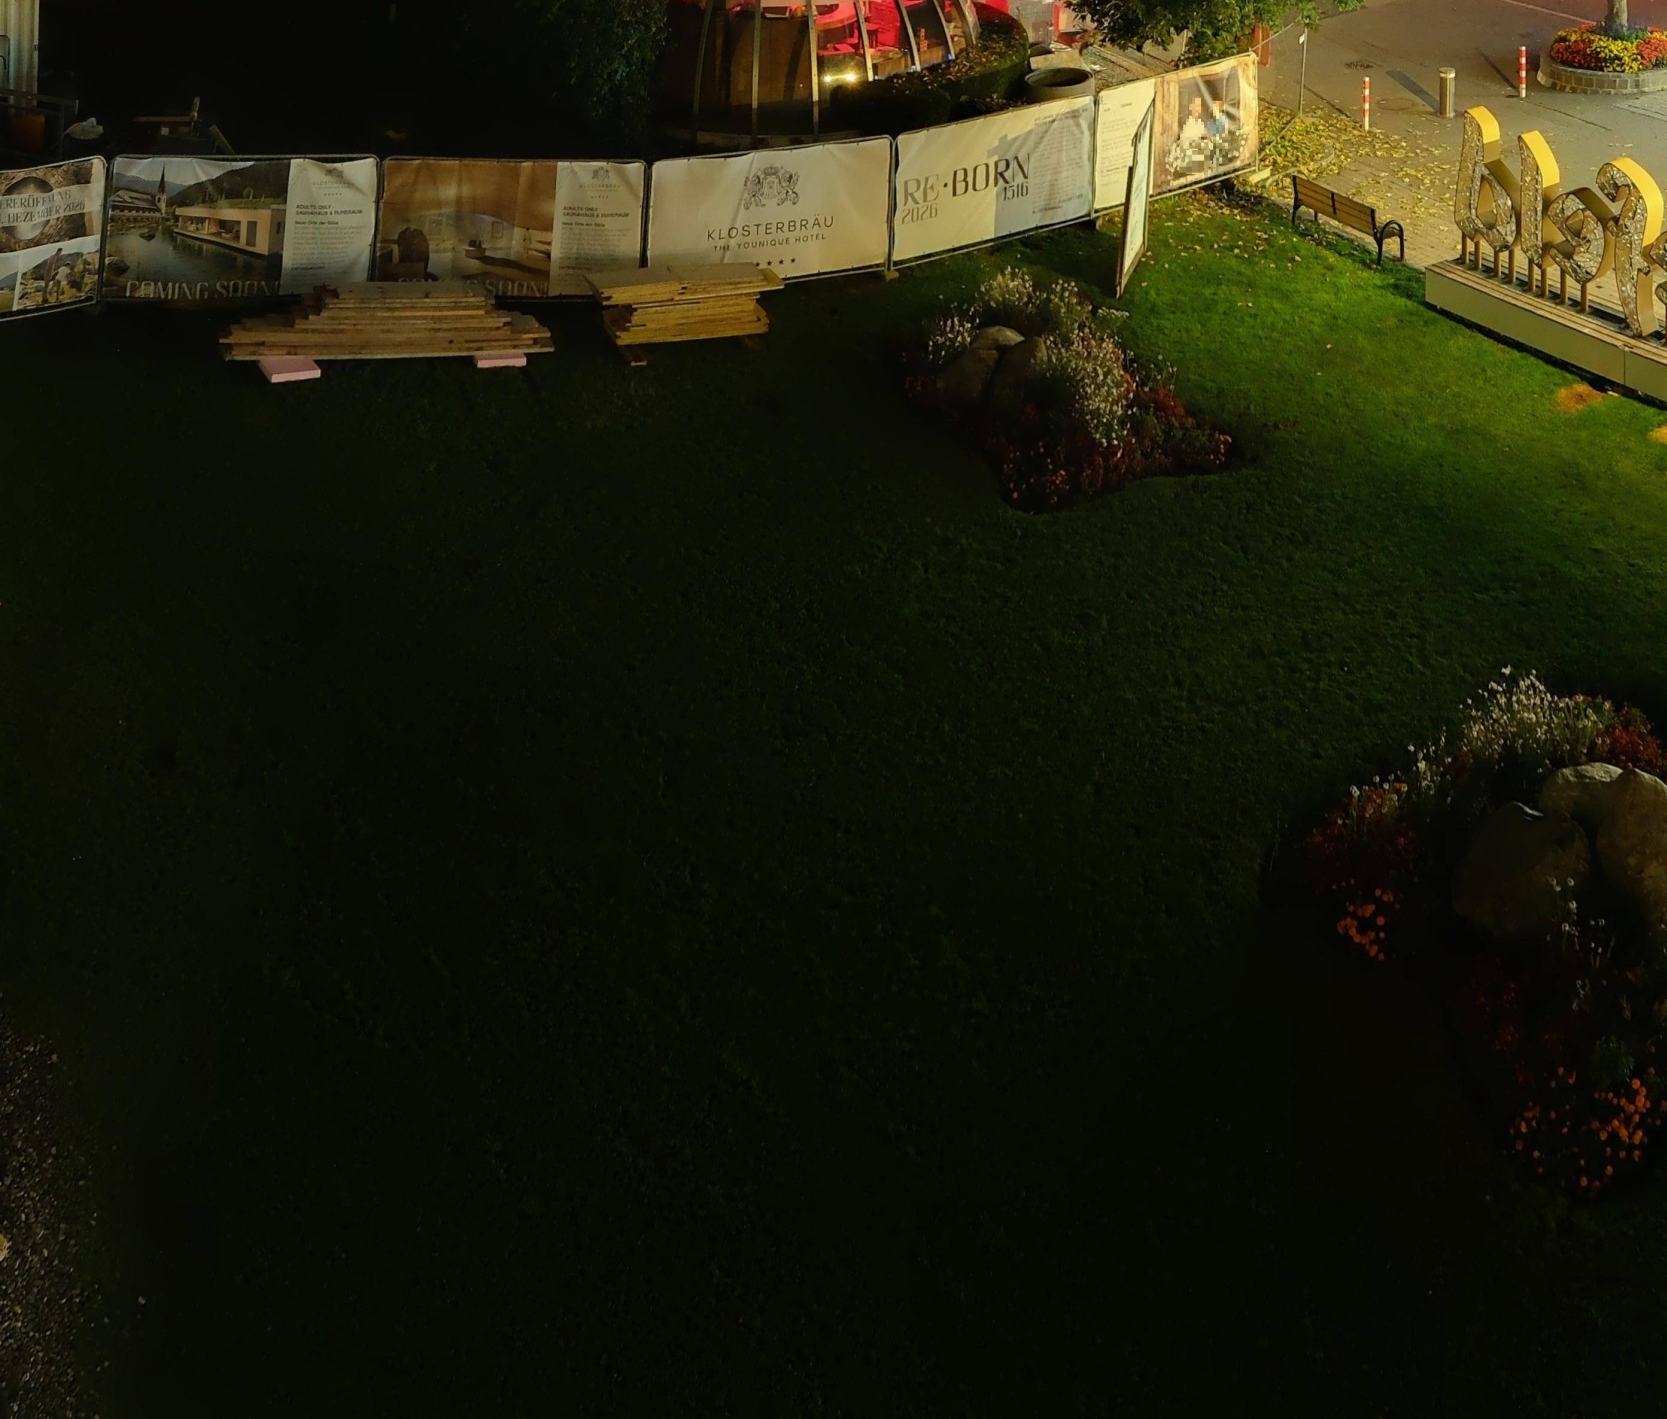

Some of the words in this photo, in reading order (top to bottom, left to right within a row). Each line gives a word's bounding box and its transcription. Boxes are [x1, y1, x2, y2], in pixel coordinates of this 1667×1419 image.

[1003, 183, 1029, 201] 1516
[901, 204, 939, 225] 2026
[706, 214, 835, 242] KLOSTERBRÄU
[737, 237, 790, 250] YOUNIQUE
[794, 233, 826, 244] HOTEL
